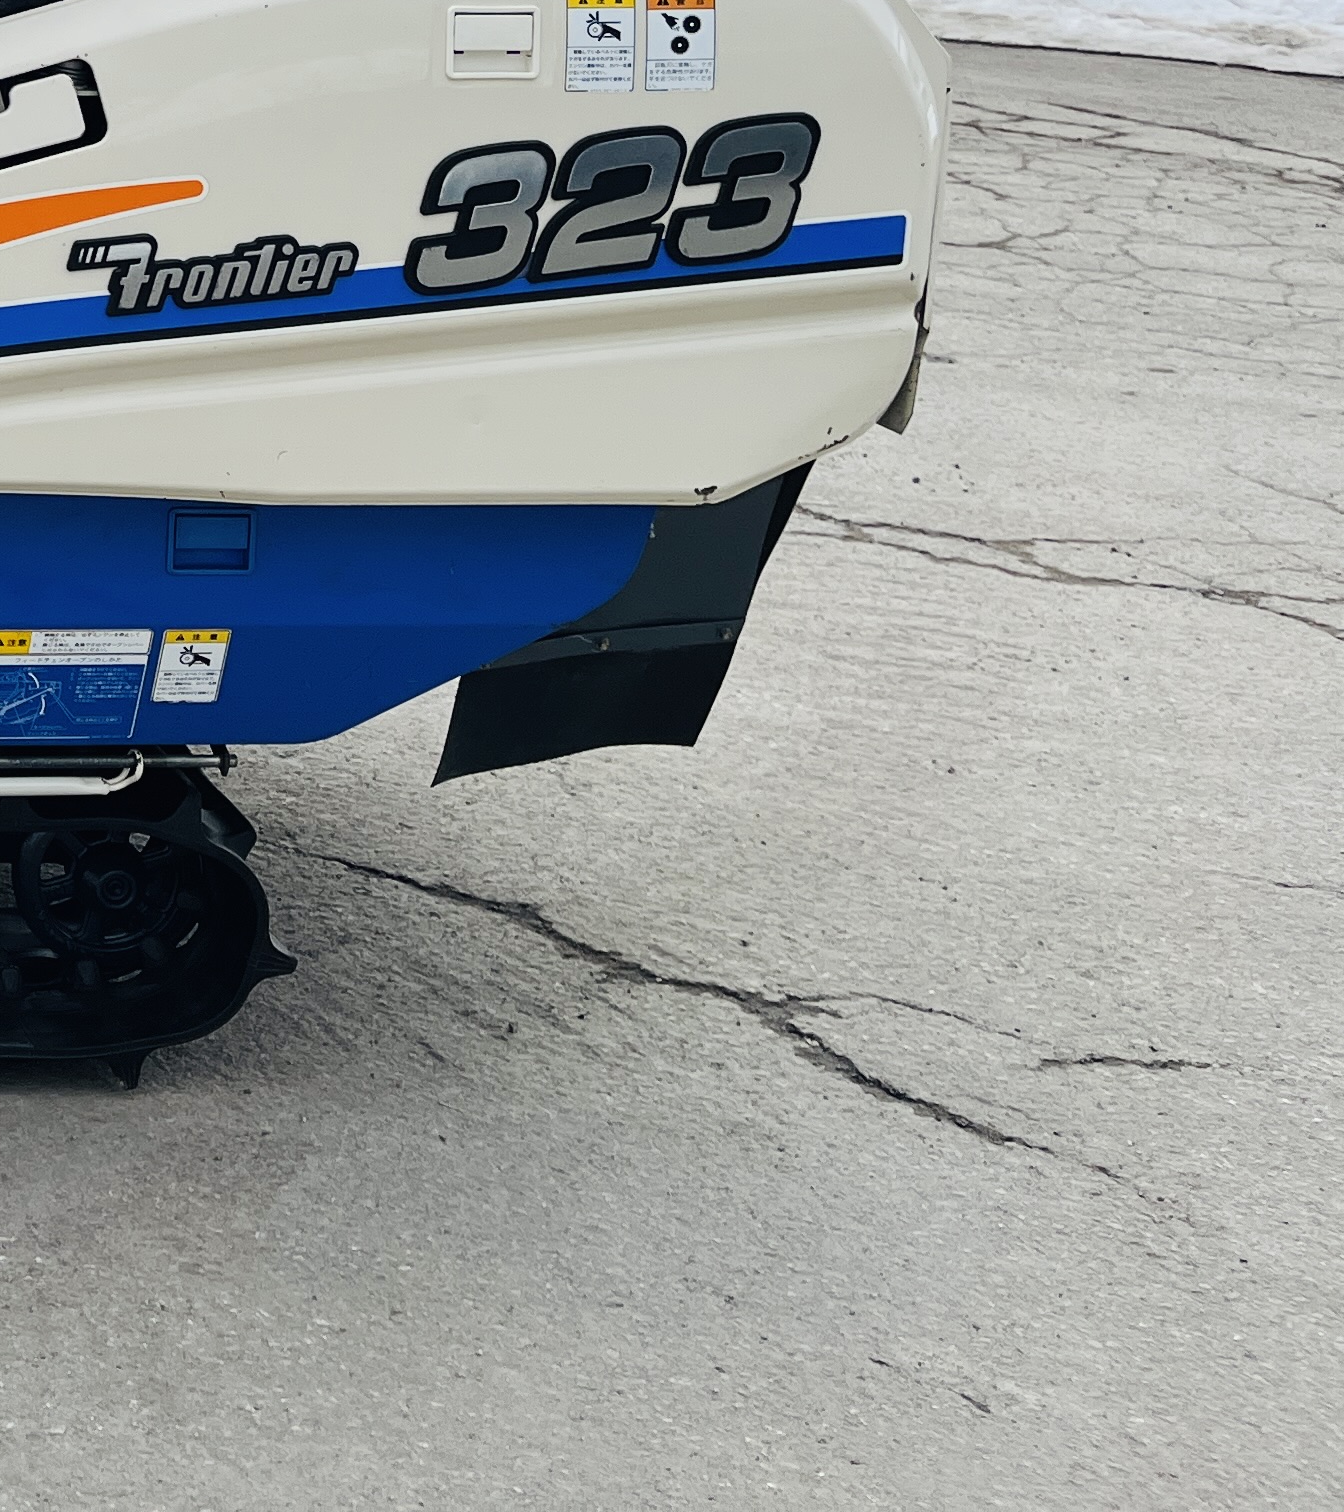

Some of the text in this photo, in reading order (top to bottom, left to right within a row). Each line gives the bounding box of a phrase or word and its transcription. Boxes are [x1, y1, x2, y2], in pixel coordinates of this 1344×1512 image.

[69, 111, 823, 317] Frontier 323
[6, 638, 28, 648] 注意
